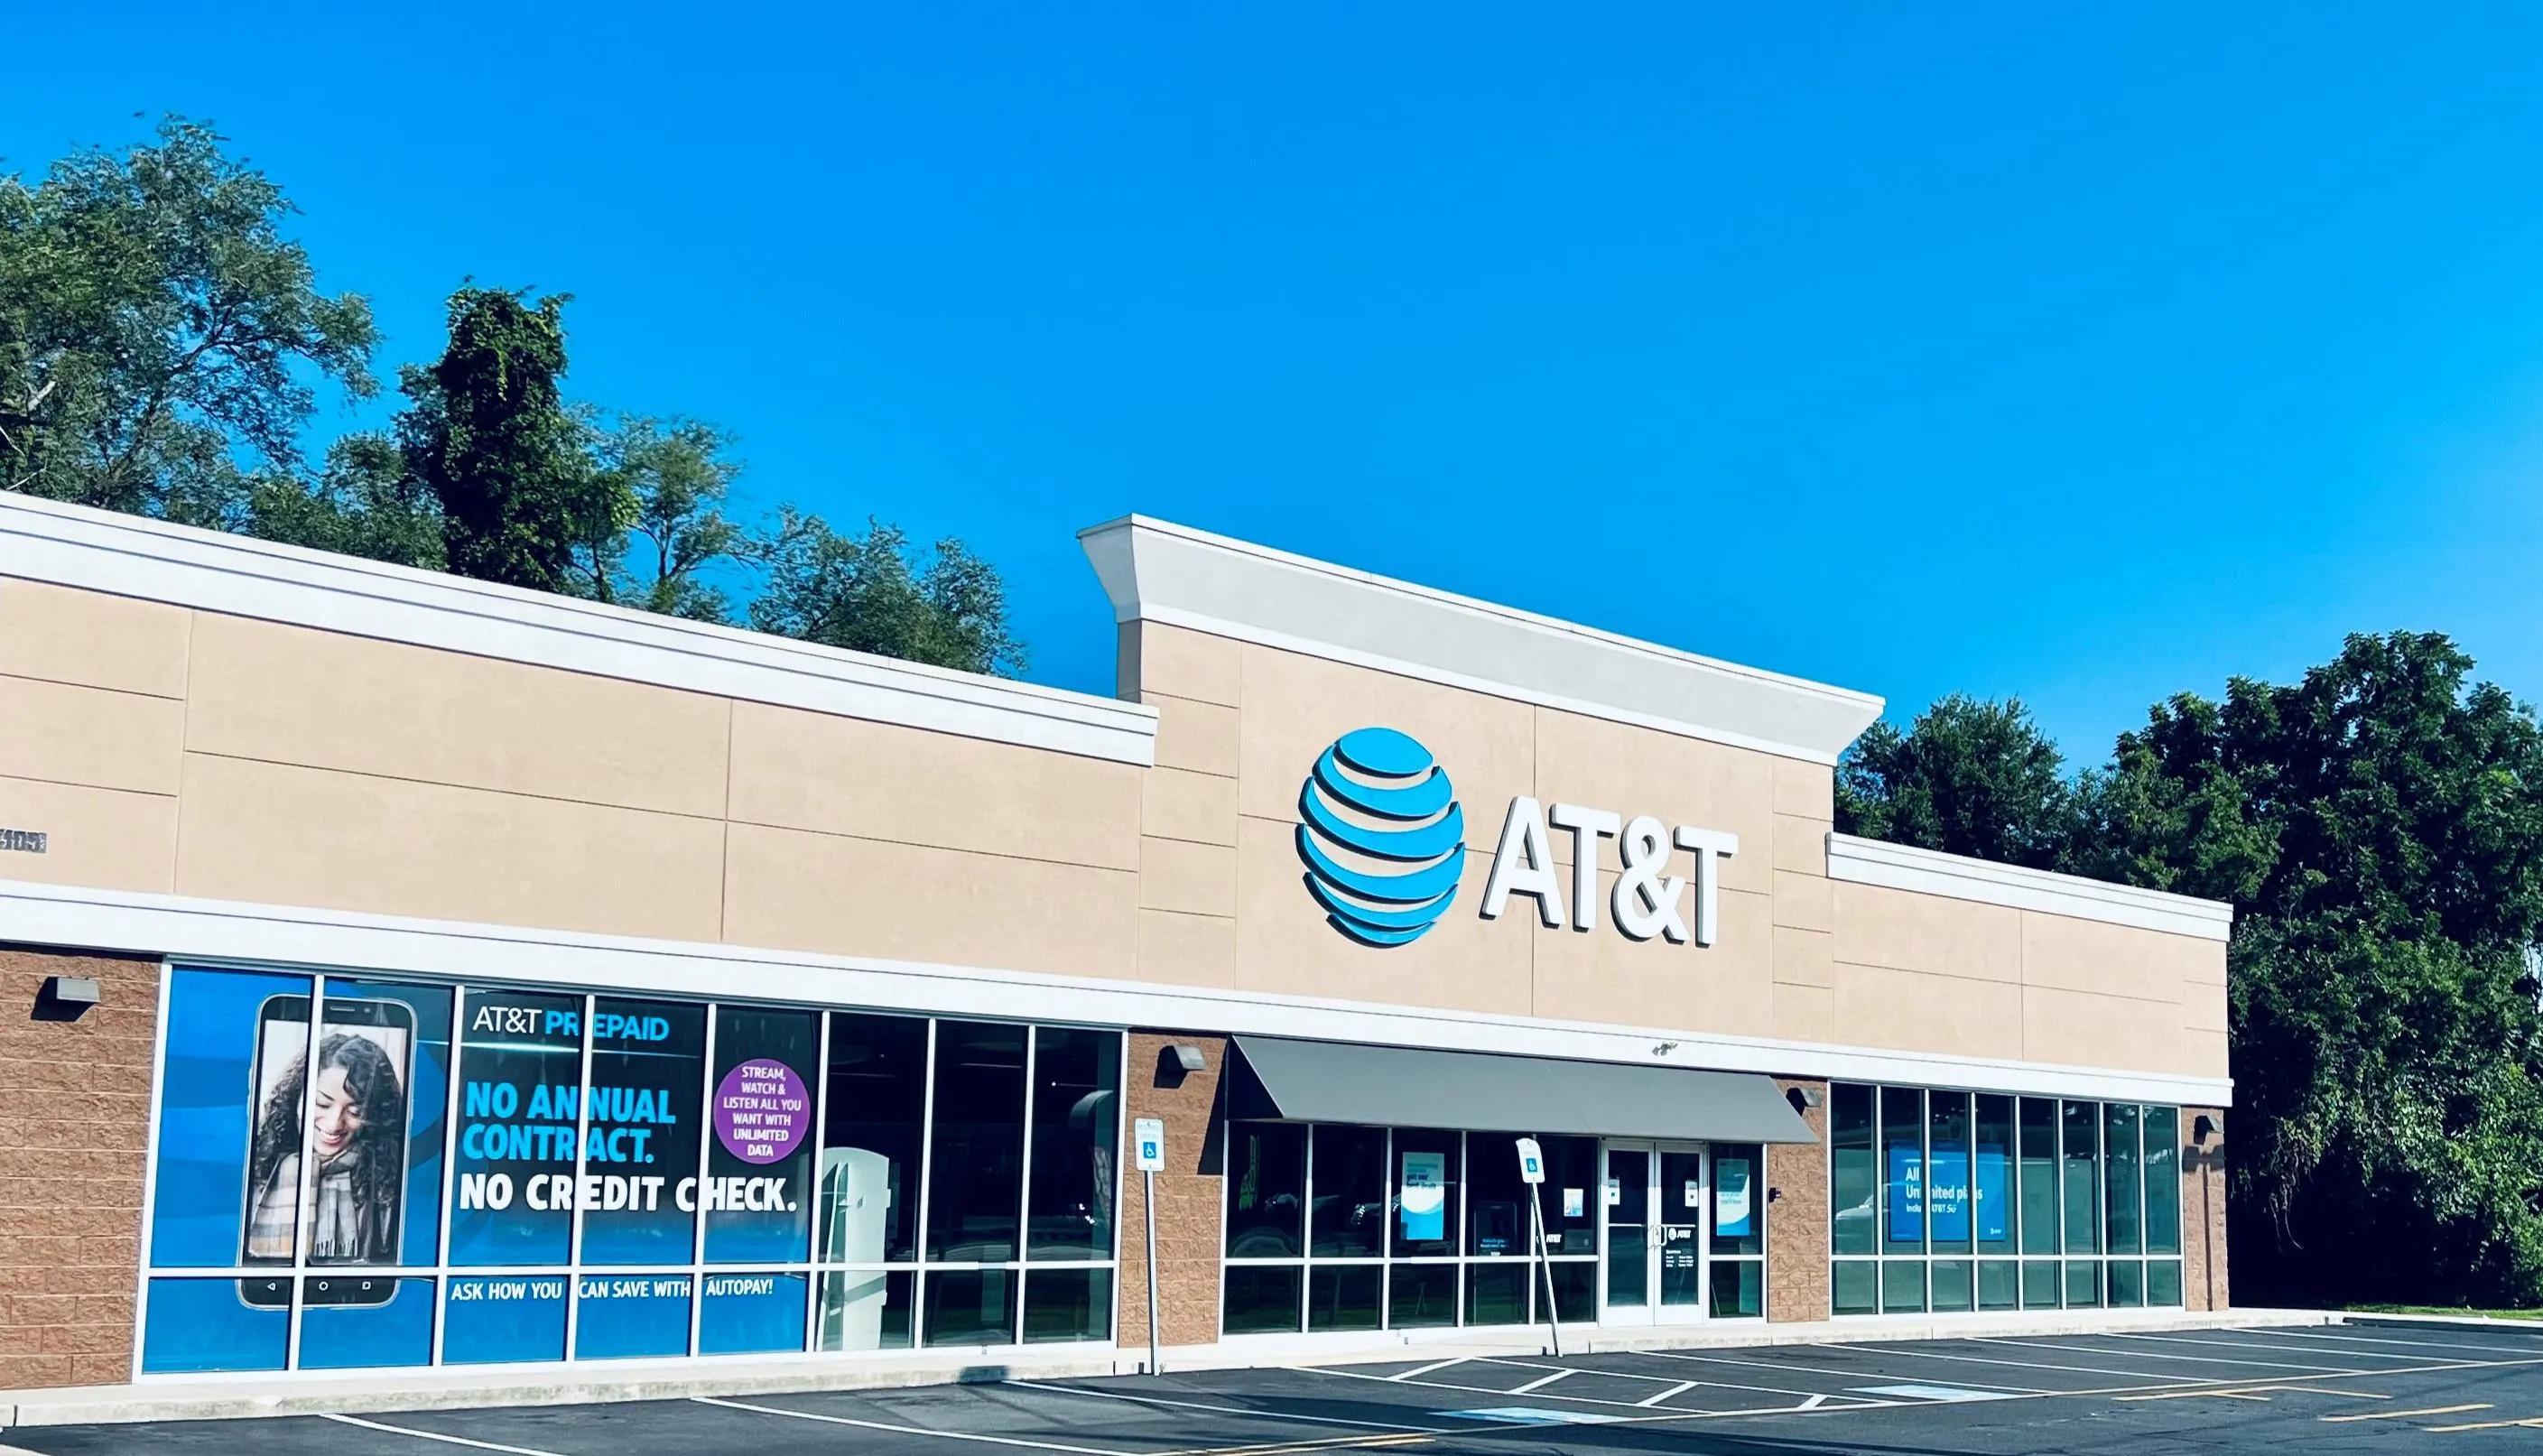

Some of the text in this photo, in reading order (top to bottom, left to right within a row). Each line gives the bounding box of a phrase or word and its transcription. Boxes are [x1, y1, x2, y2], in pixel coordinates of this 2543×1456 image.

[1480, 795, 1740, 949] AT&T
[472, 1005, 670, 1041] AT&T PREPAID
[741, 1066, 786, 1081] STREAM,
[741, 1082, 786, 1095] WATCH &
[465, 1081, 676, 1124] NO ANNUAL
[723, 1097, 802, 1111] LISTEN ALL YOU
[732, 1113, 792, 1126] WANT WITH
[733, 1128, 790, 1142] UNLIMITED
[463, 1123, 654, 1164] CONTRACT.
[747, 1144, 774, 1156] DATA
[1905, 1167, 1920, 1182] All
[459, 1173, 797, 1212] NO CREDIT CHECK.
[451, 1278, 774, 1300] ASK HOW YOU CAN SAVE WITH AUTOPAY!
